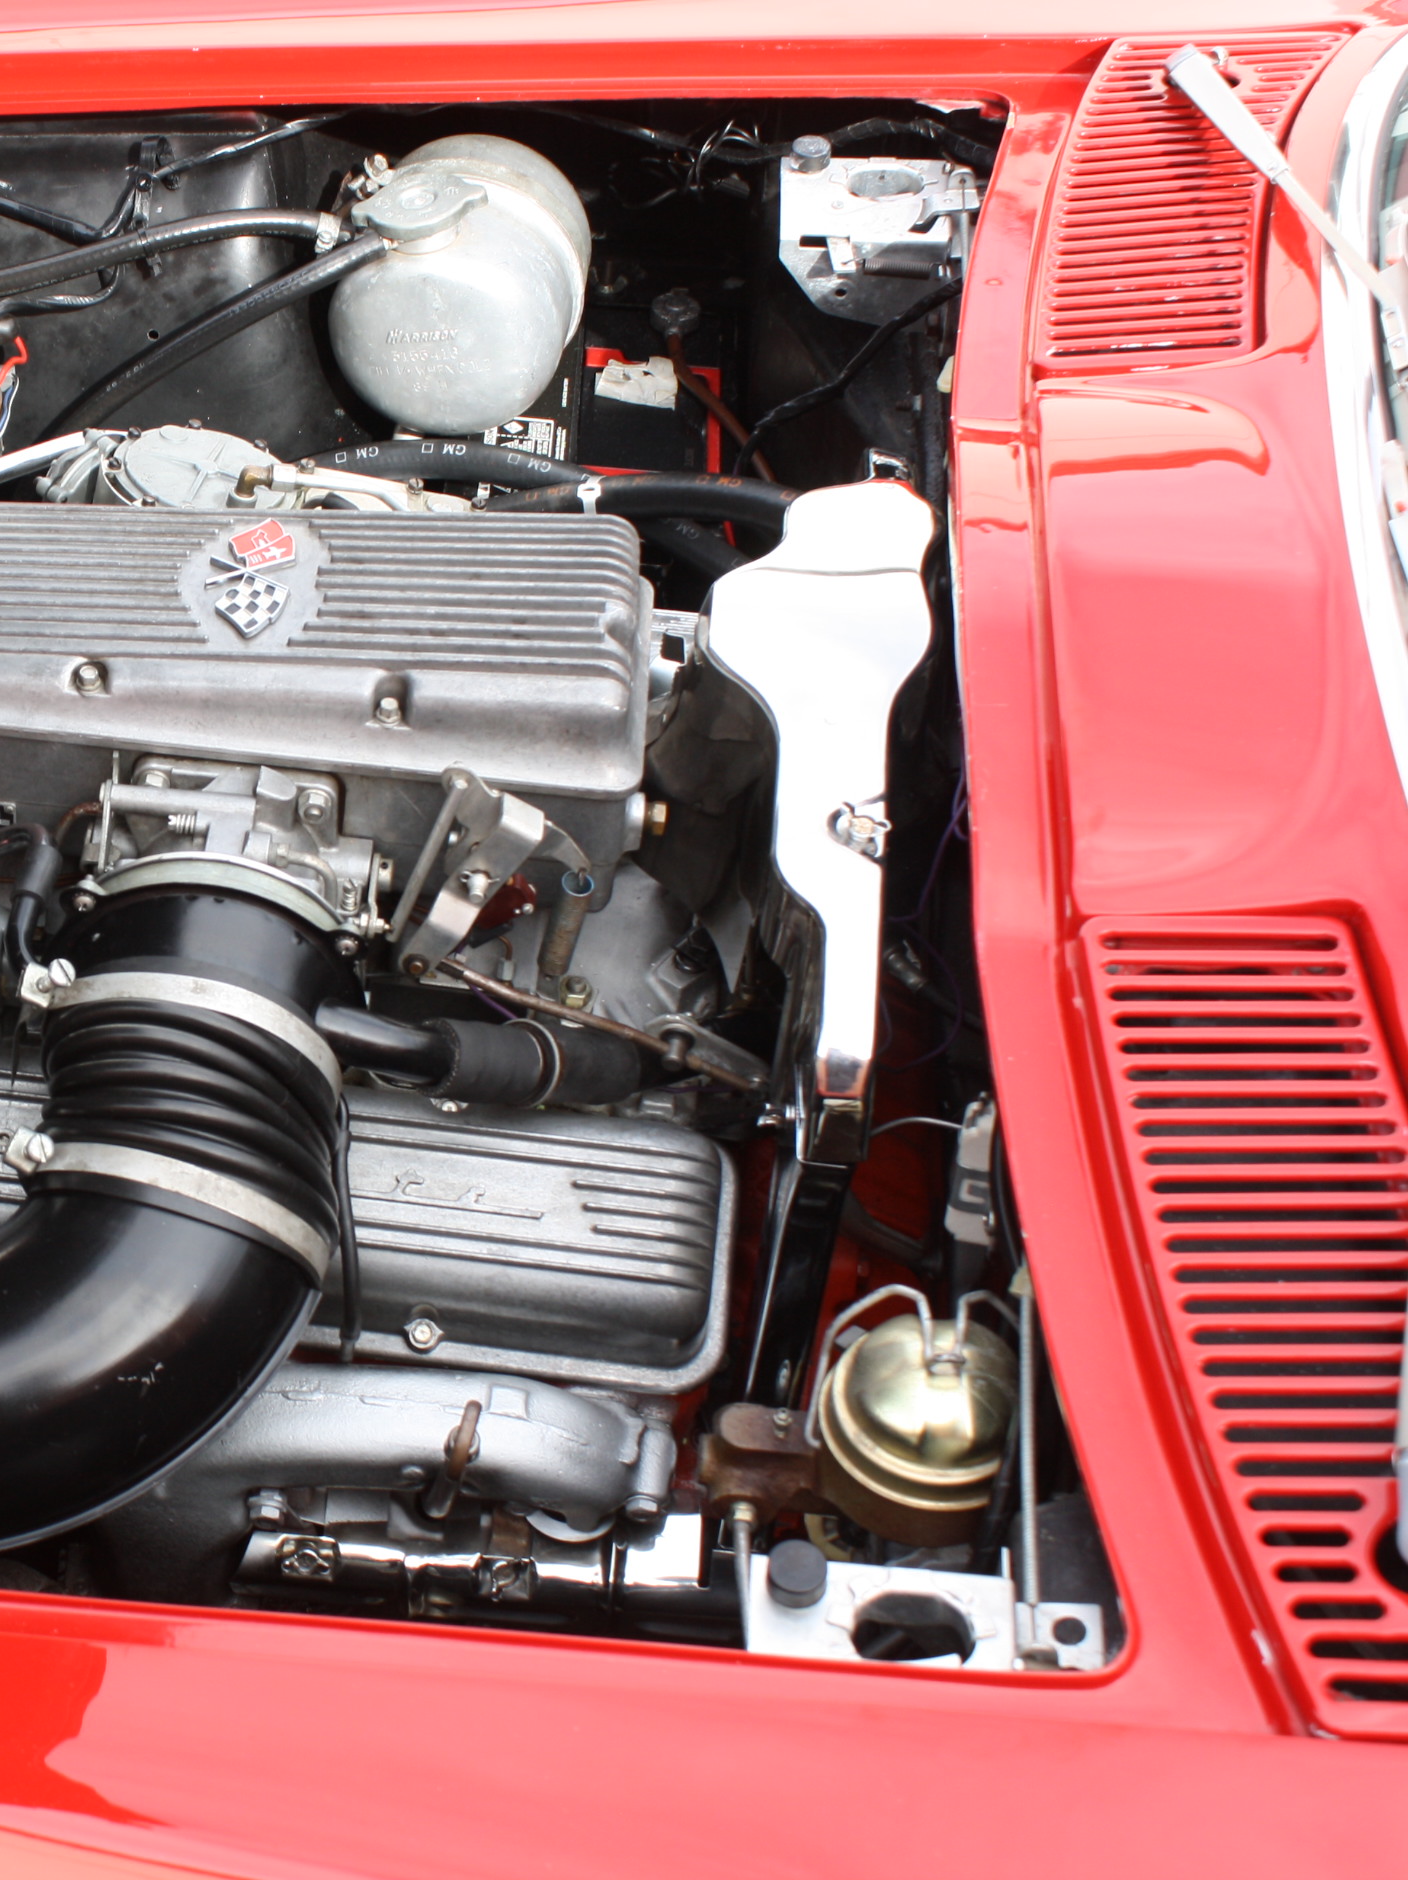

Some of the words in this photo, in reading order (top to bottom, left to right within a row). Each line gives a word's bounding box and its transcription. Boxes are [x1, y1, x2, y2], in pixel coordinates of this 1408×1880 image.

[386, 329, 458, 345] HARRISON
[356, 446, 379, 459] GM
[442, 443, 466, 456] GM
[528, 458, 552, 473] GM
